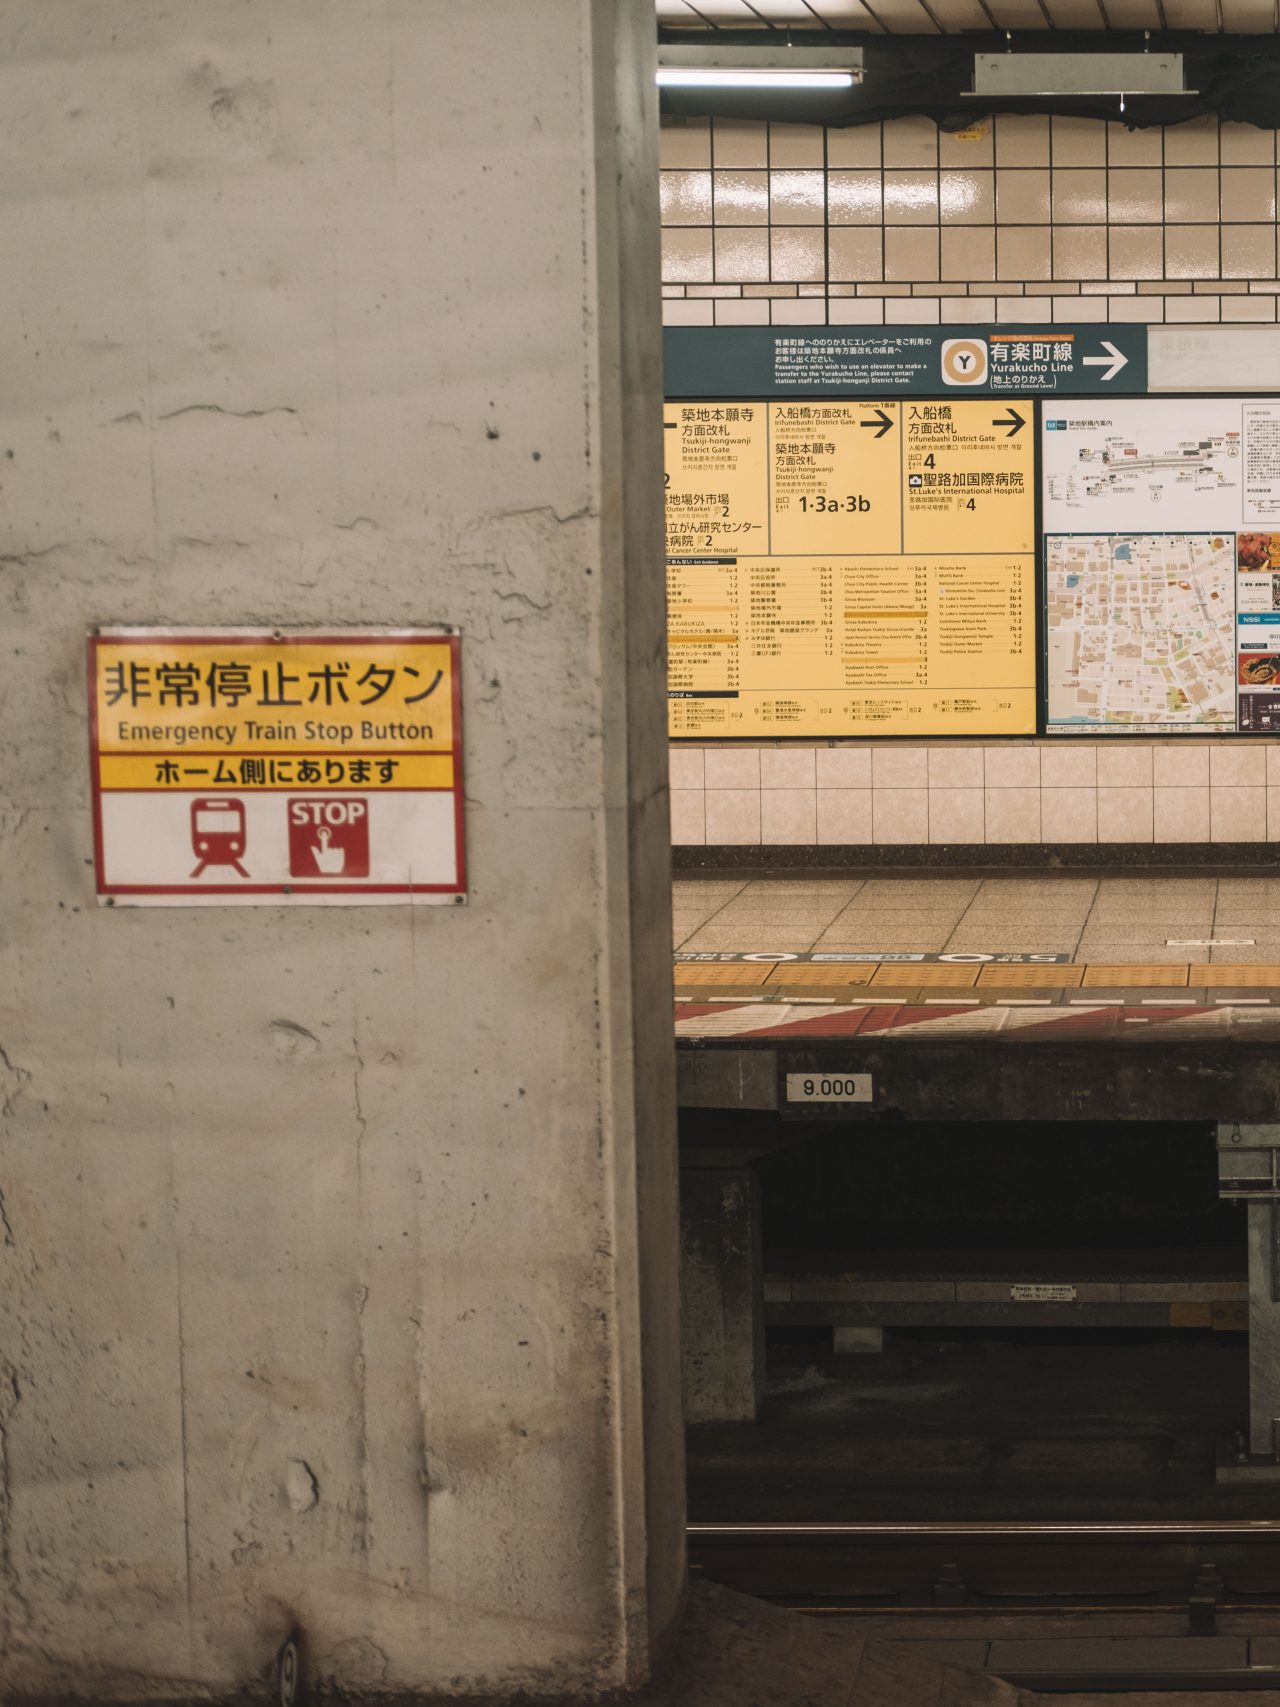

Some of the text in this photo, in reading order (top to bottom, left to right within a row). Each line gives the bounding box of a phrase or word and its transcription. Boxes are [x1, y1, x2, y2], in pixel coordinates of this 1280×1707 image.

[775, 347, 902, 355] お客様は築地本願寺方面改札の係員へ
[990, 343, 1073, 361] 有楽町線
[958, 355, 971, 370] Y
[991, 363, 1073, 372] Yurakucho Line
[822, 377, 870, 385] Tsukiji-honganji
[681, 408, 754, 422] 築地本願寺
[775, 407, 852, 419] 入船橋方面改札
[909, 406, 952, 420] 入船橋
[681, 424, 730, 436] 方面改札
[909, 423, 957, 434] 方面改札
[682, 437, 751, 446] Tsukiji-hongwanji
[776, 443, 836, 455] 築地本願寺
[776, 456, 816, 466] 方面改札
[923, 454, 936, 469] 4
[923, 472, 1024, 486] 聖路加国際病院
[994, 487, 1025, 495] Hospital
[966, 498, 976, 511] 4
[722, 506, 729, 517] 2
[666, 522, 762, 533] 立がん研究センター
[705, 535, 712, 546] 2
[104, 661, 444, 708] 非常停止ボタン
[118, 720, 434, 744] Emergency Train Stop Button
[154, 759, 400, 785] ホーム側にあります
[292, 801, 365, 825] STOP
[803, 1079, 855, 1096] 9.000
